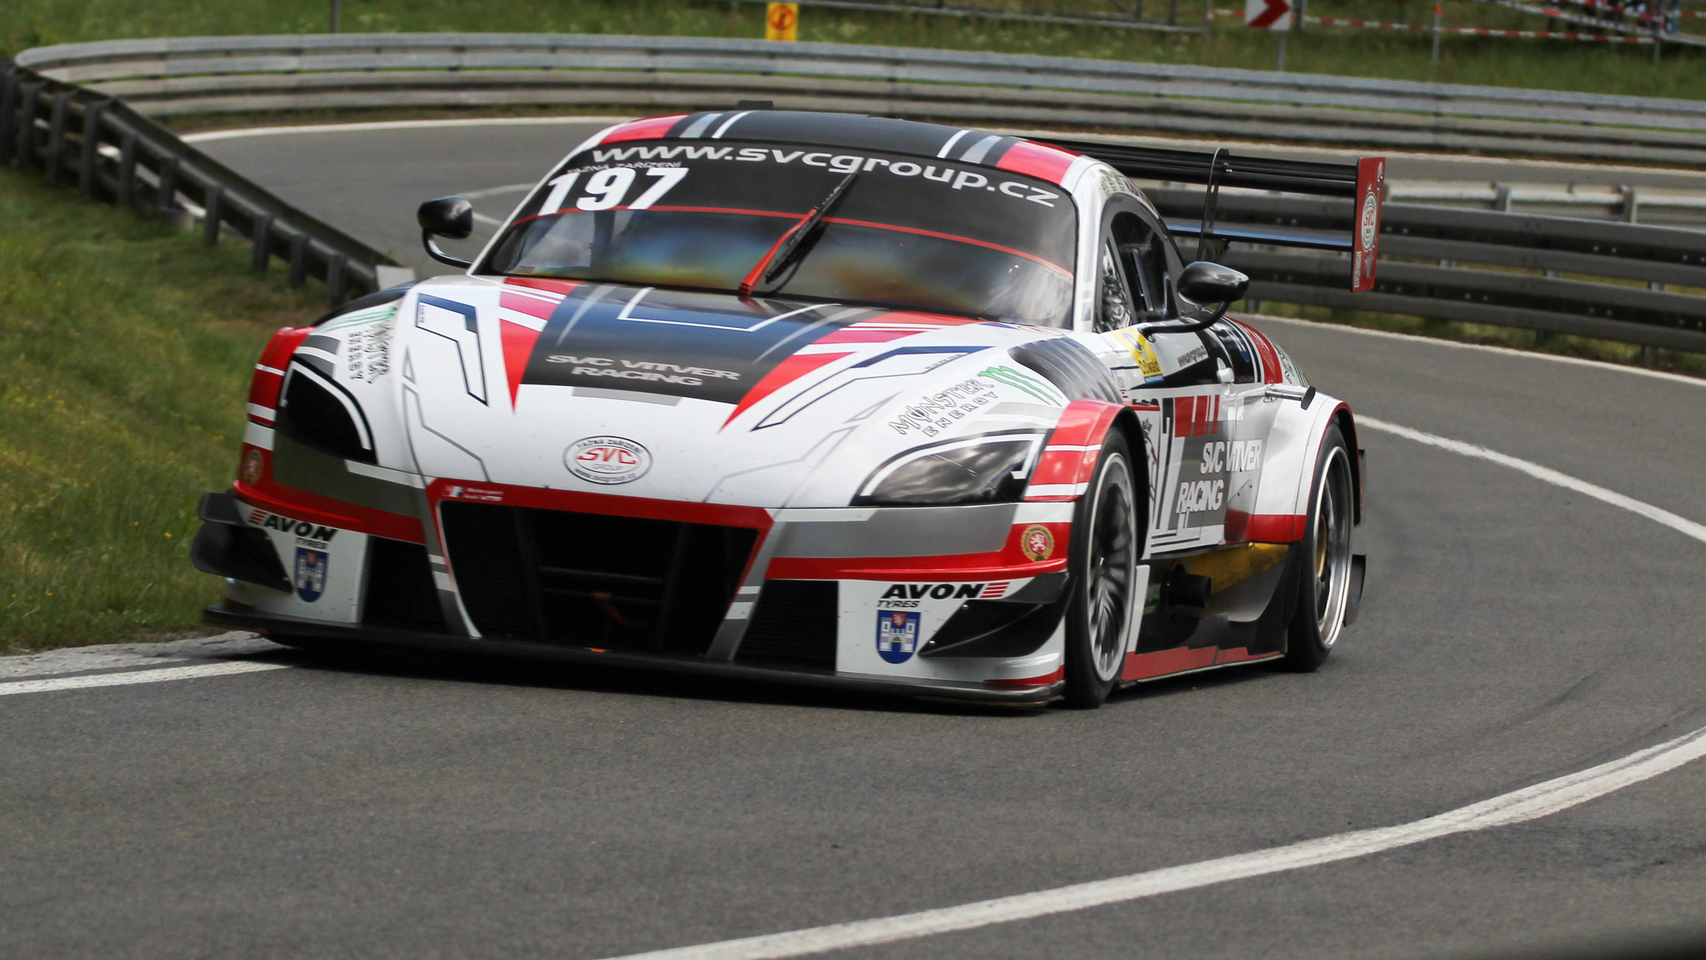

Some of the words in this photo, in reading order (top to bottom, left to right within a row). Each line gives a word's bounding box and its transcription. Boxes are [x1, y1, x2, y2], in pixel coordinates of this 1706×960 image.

[593, 146, 1060, 208] www.svcgroup.cz
[538, 167, 689, 216] 197
[546, 355, 613, 366] SVC
[620, 359, 741, 380] VITVER
[571, 366, 703, 386] RACING
[888, 379, 994, 435] MONSTER
[922, 391, 998, 437] ENERGY
[576, 447, 637, 465] SVC
[1201, 441, 1225, 474] SVC
[1225, 439, 1261, 472] VITVER
[1176, 479, 1224, 513] RACING
[263, 514, 338, 542] AVON
[295, 537, 328, 549] TYRES
[877, 600, 920, 608] TYRES
[881, 583, 985, 600] AVON
